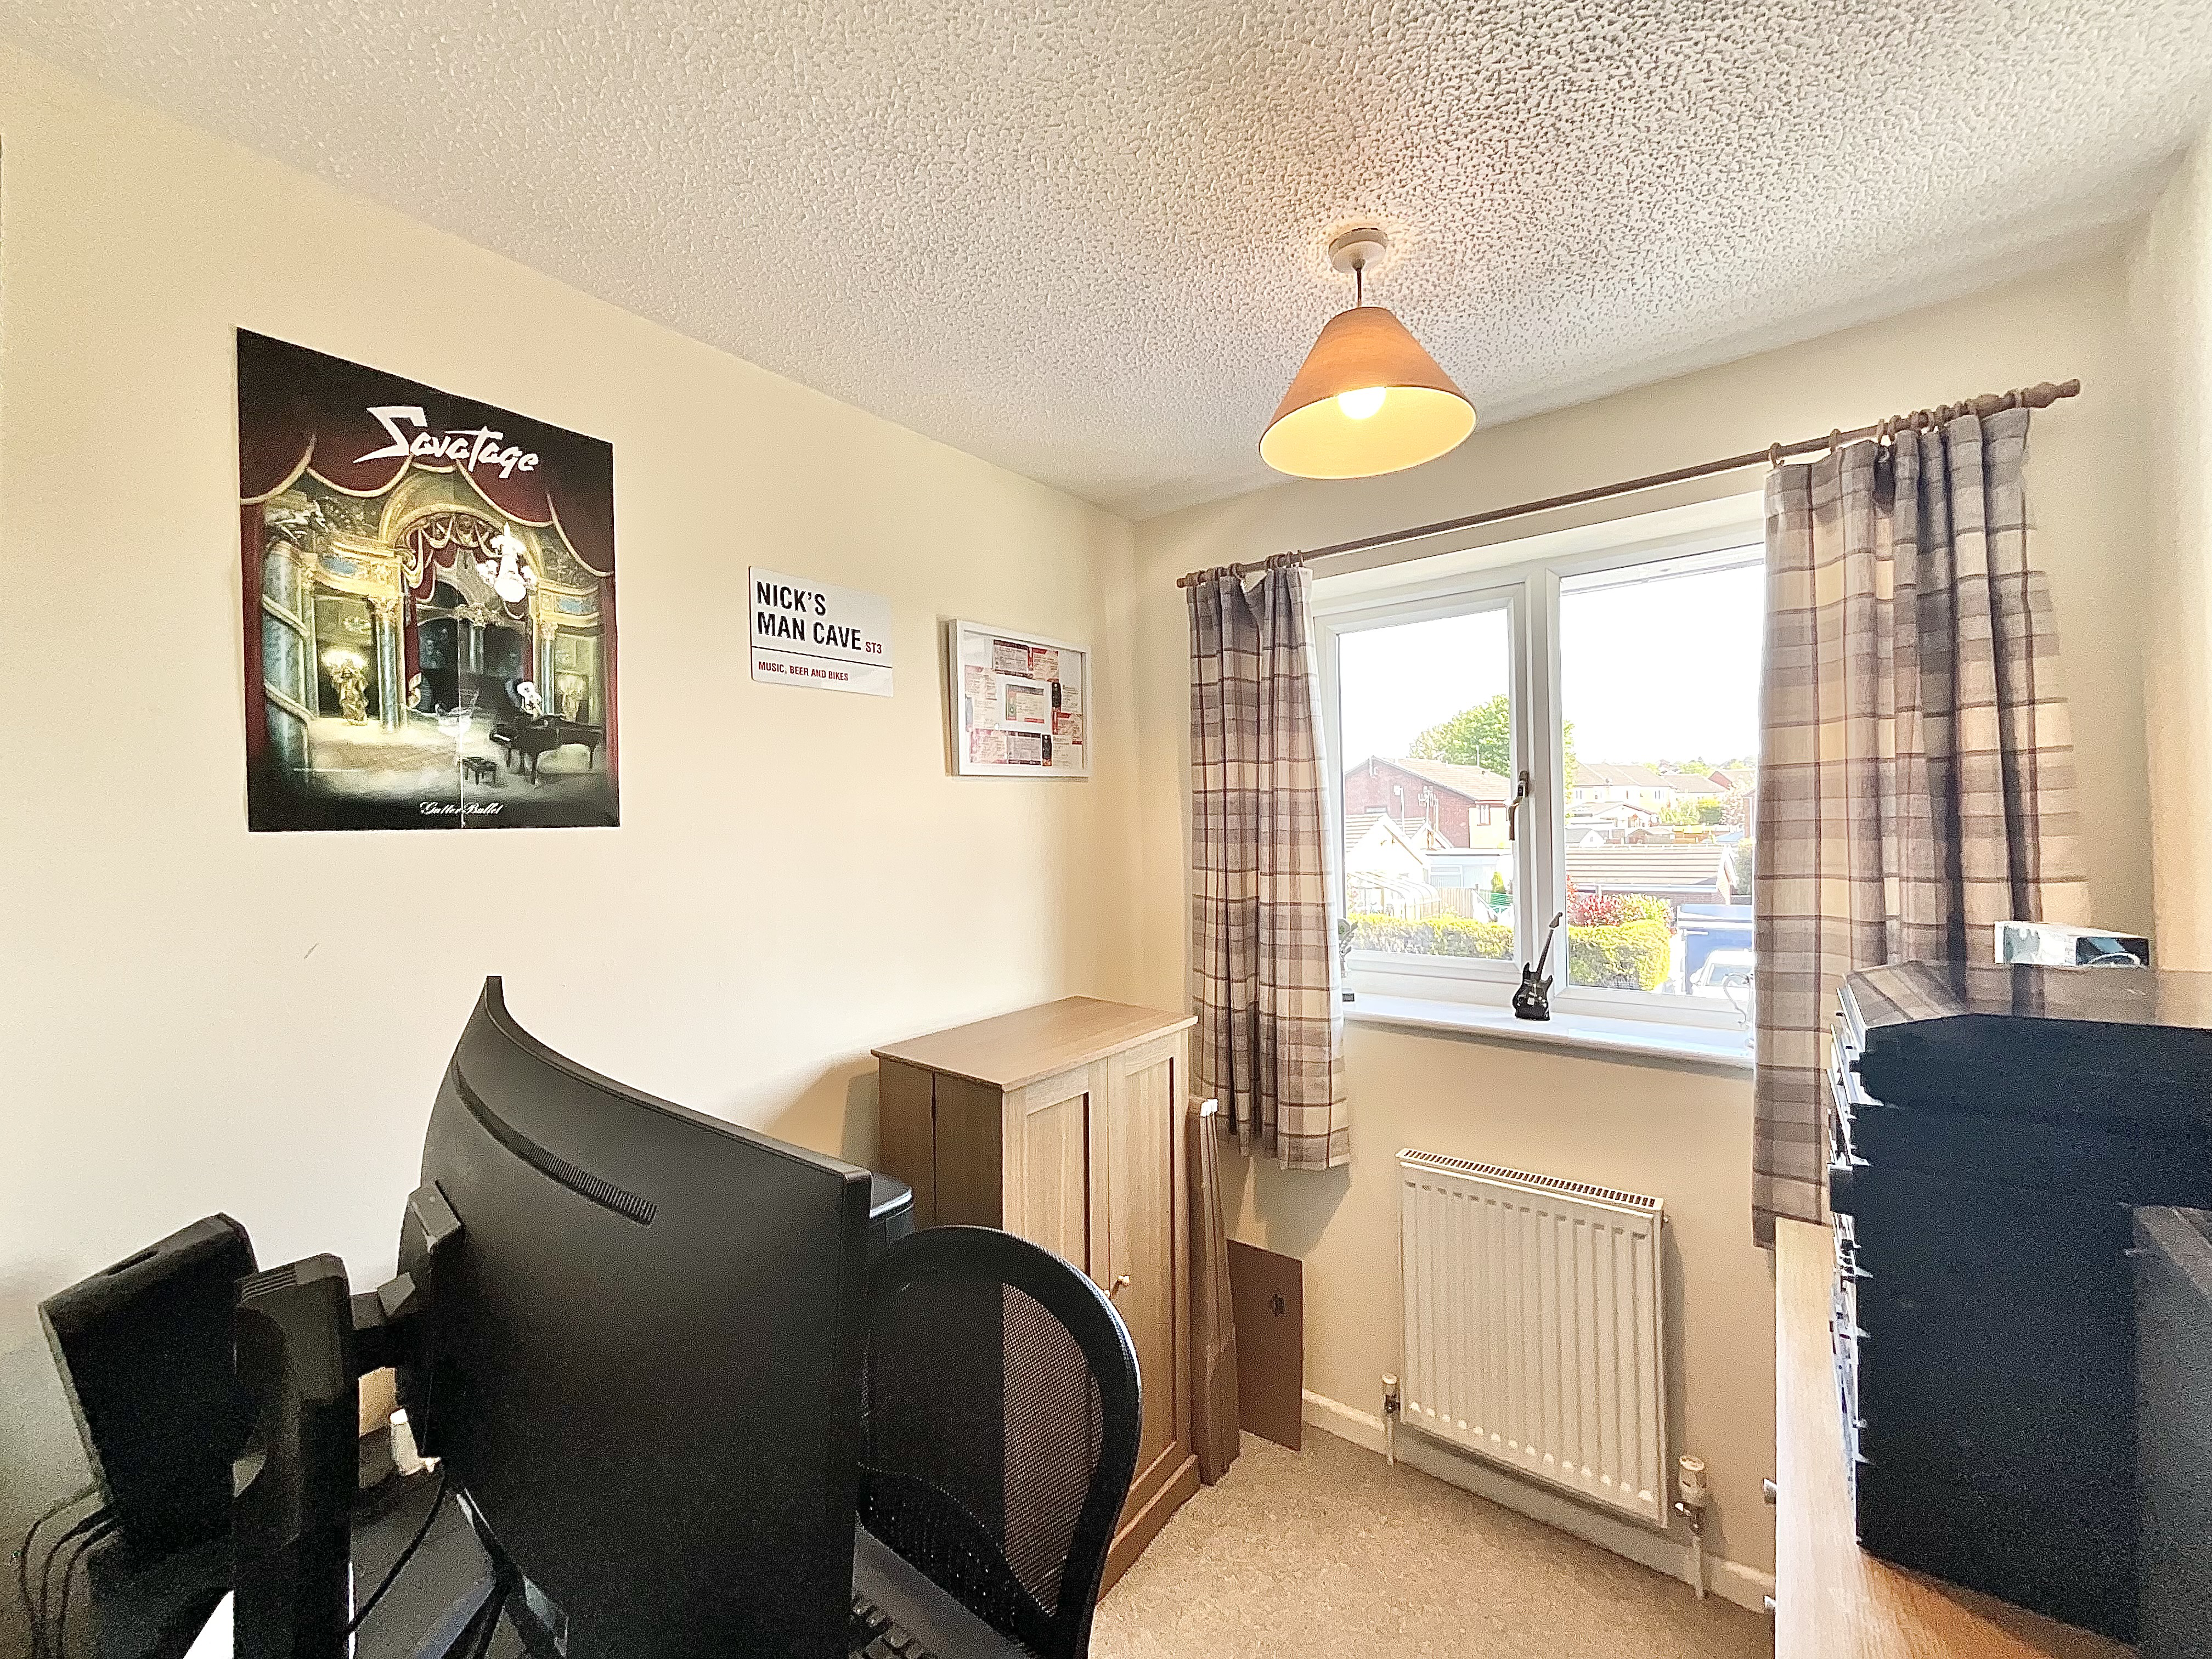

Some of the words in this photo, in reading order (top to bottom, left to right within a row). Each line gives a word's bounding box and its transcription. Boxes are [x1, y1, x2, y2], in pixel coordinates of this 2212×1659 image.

[757, 581, 826, 616] NICK'S
[758, 612, 805, 641] MAN
[813, 622, 861, 651] CAVE
[865, 642, 882, 654] ST3
[758, 661, 787, 674] MUSIC,
[789, 665, 809, 676] BEER
[811, 668, 826, 678] AND
[828, 670, 848, 681] BIKES
